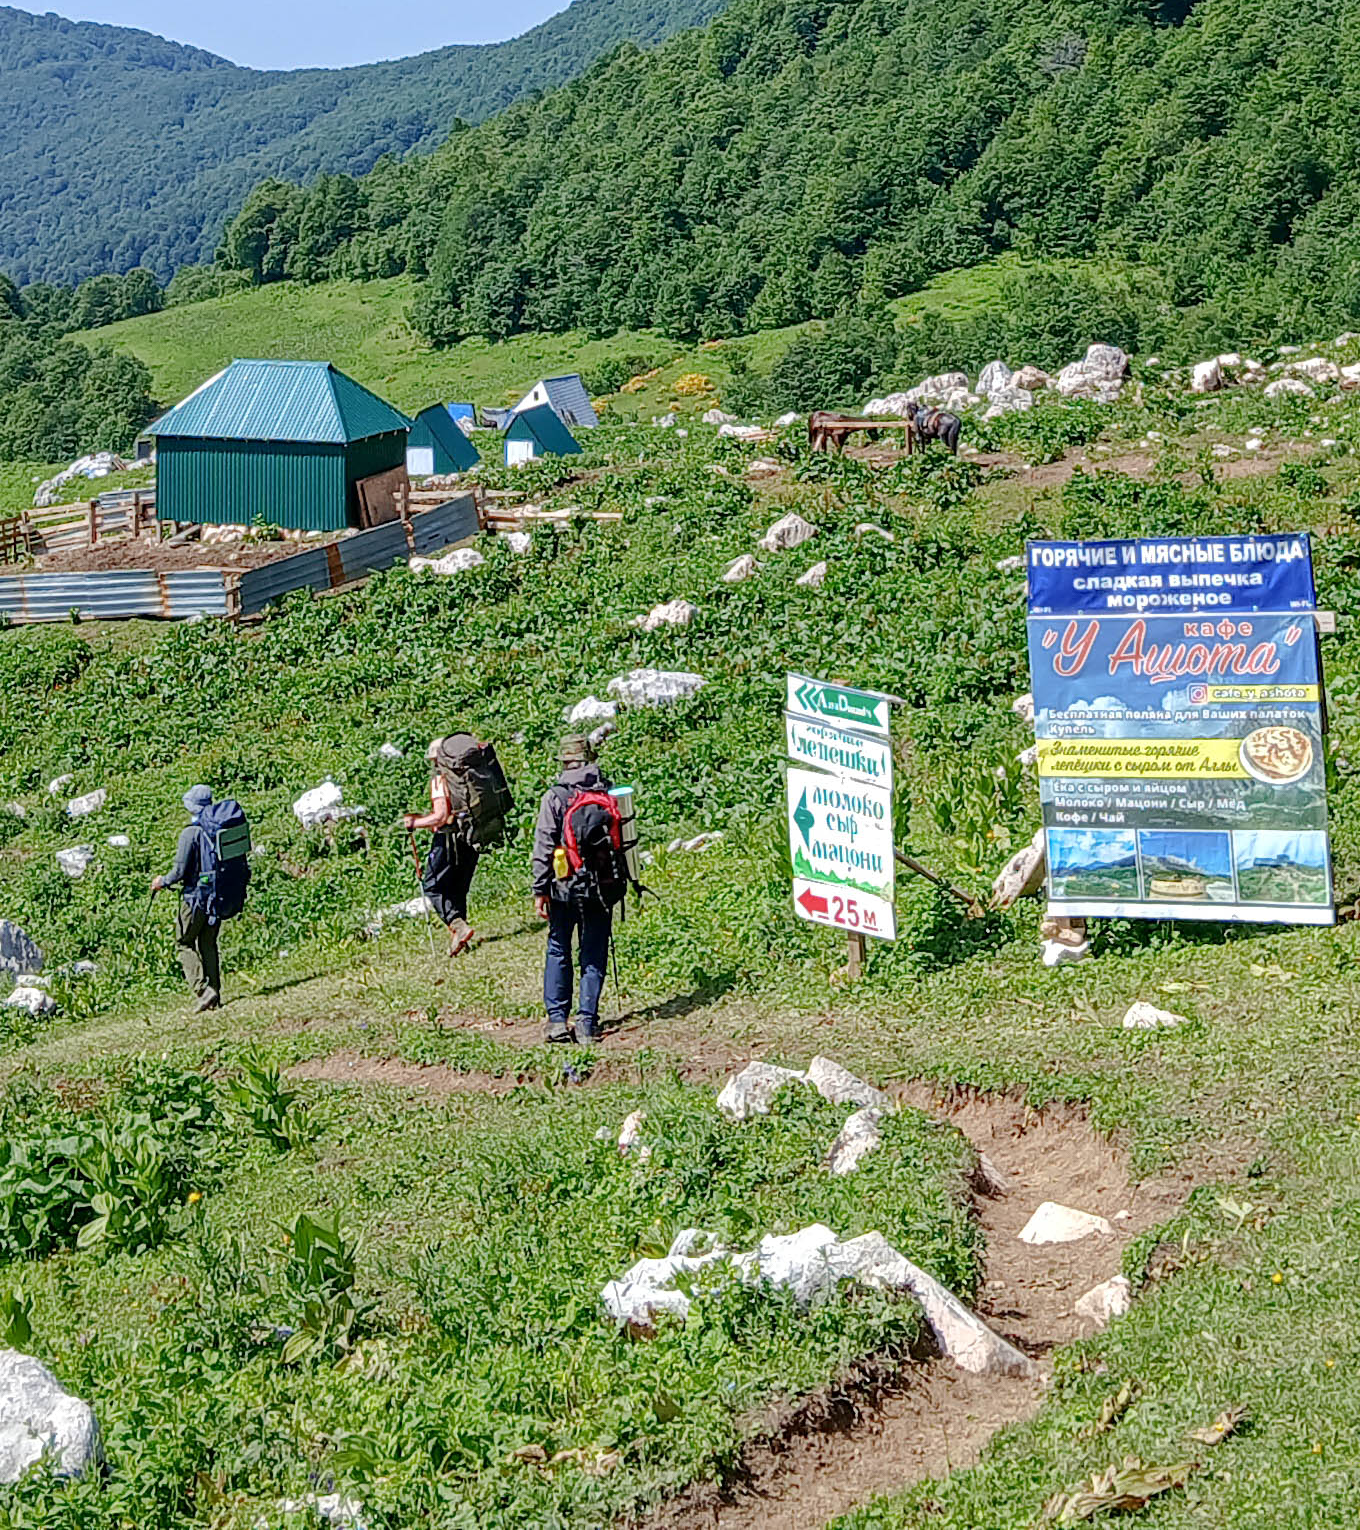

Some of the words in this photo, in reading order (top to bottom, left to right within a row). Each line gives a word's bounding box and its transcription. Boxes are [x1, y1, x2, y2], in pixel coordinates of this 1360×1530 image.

[1031, 547, 1118, 567] ГОРЯЧИЕ
[1121, 545, 1136, 565] И
[1141, 543, 1226, 565] МЯСНЫЕ
[1229, 540, 1304, 564] БЛЮДА
[1072, 574, 1163, 591] сладкая
[1168, 572, 1263, 588] выпечка
[1107, 592, 1232, 611] мороженое
[1184, 618, 1253, 640] кафе
[1049, 710, 1123, 720] Бесплатная
[1125, 710, 1172, 720] поляна
[1175, 710, 1199, 722] для
[1202, 709, 1247, 719] Ваших
[1249, 710, 1307, 719] палаток
[1049, 724, 1096, 737] Купель
[1050, 740, 1141, 757] Знаменитые
[1143, 745, 1200, 760] горячие
[1113, 761, 1123, 771] с
[1125, 761, 1172, 775] сыром
[1175, 762, 1196, 772] от
[1077, 783, 1085, 792] с
[1087, 783, 1130, 795] сыром
[1132, 783, 1141, 792] и
[1143, 781, 1187, 796] яйцом
[1054, 796, 1105, 807] Молоко
[1115, 798, 1168, 811] Мацони
[1178, 798, 1205, 811] Сыр
[1216, 798, 1246, 811] Мёд
[1055, 811, 1088, 824] Кофе
[1098, 811, 1125, 823] Чай
[826, 812, 858, 844] сыр
[812, 839, 883, 874] мацони
